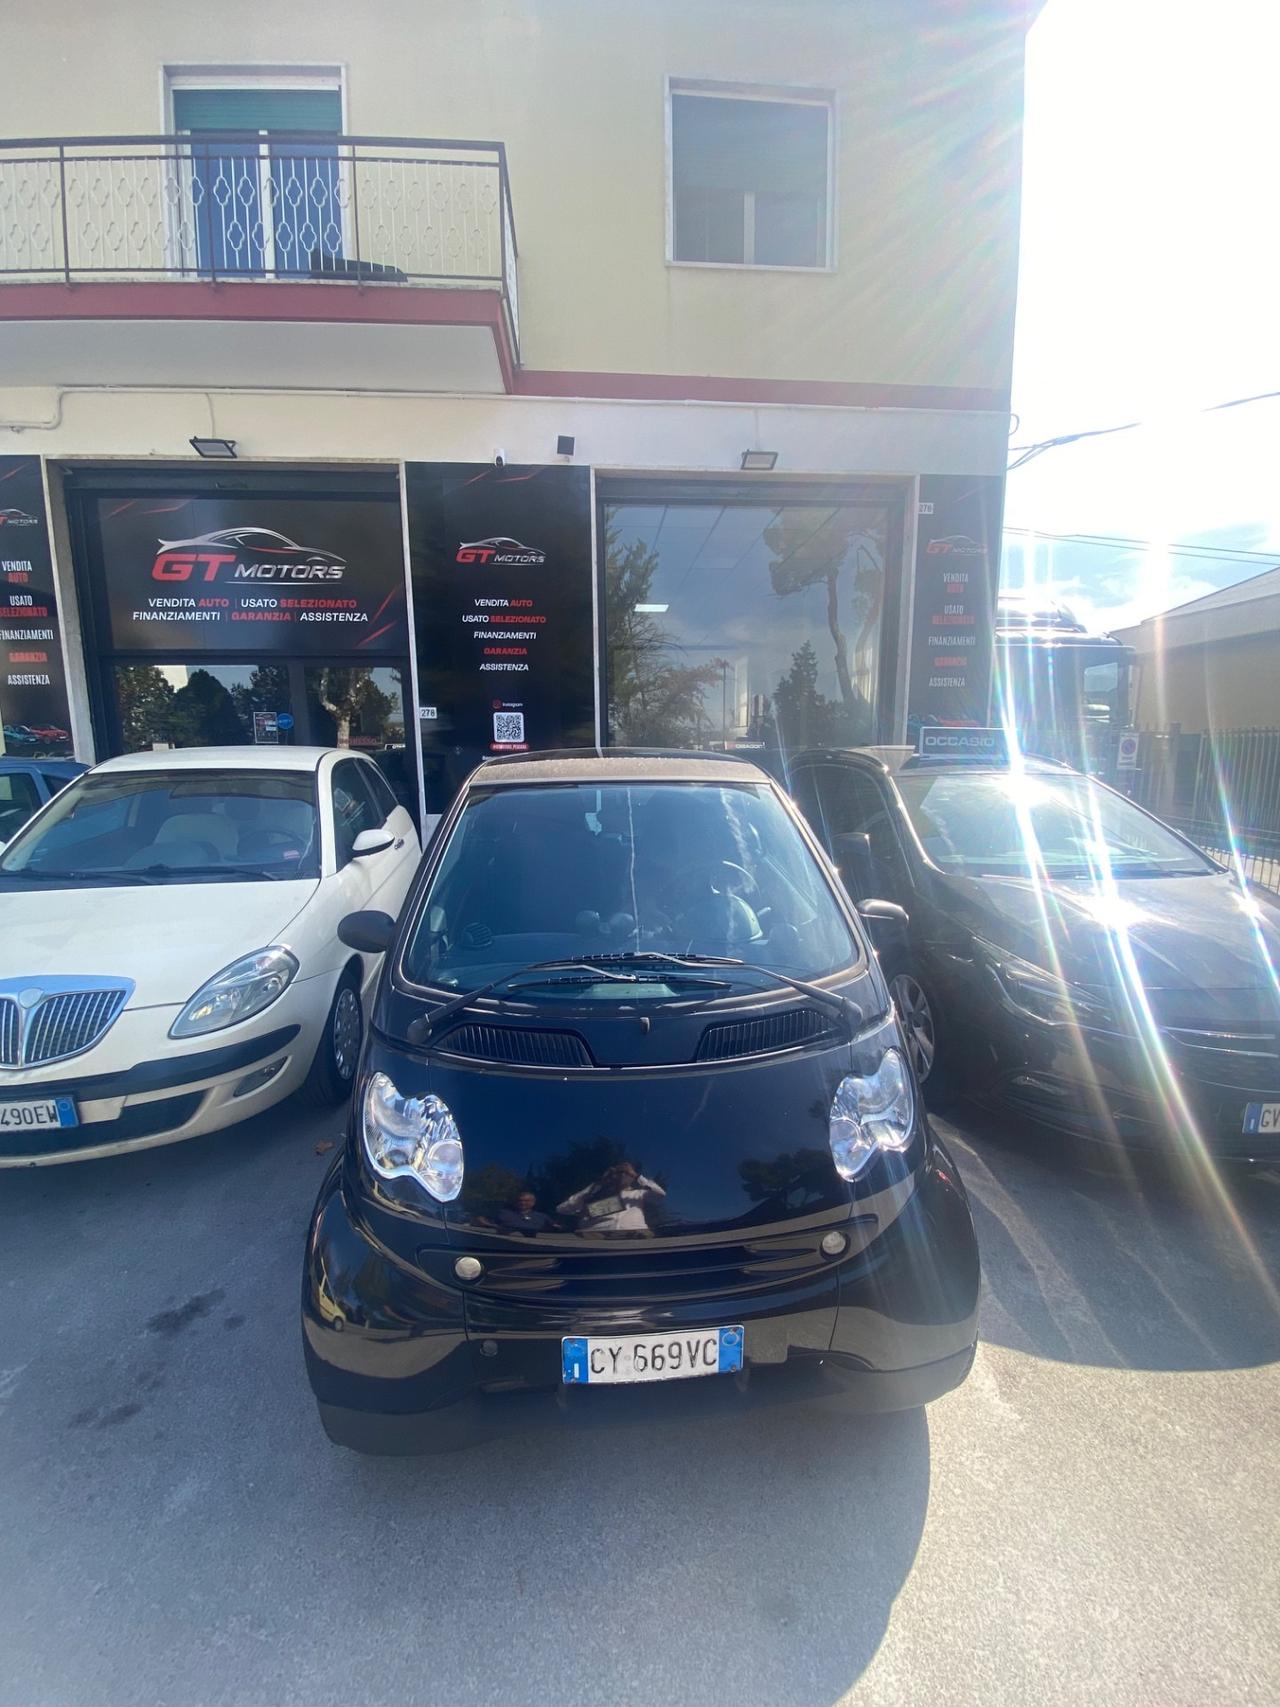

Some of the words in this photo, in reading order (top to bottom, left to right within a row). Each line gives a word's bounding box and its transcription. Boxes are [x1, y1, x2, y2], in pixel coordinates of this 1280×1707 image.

[456, 548, 496, 563] GT
[494, 555, 545, 563] MOTORS
[2, 561, 32, 571] VENDITA
[152, 554, 236, 582] GT
[234, 564, 346, 579] MOTORS
[10, 595, 33, 606] USATO
[148, 598, 196, 608] VENDITA
[198, 599, 230, 608] AUTO
[241, 598, 278, 608] USATO
[280, 599, 358, 609] SELEZIONATO
[474, 599, 509, 607] VENDITA
[132, 612, 221, 621] FINANZIAMENTI
[231, 612, 292, 621] GARANZIA
[300, 612, 369, 622] ASSISTENZA
[462, 615, 490, 623] USATO
[490, 615, 547, 624] SELEZIONATO
[473, 631, 537, 640] FINANZIAMENTI
[483, 648, 528, 656] GARANZIA
[479, 663, 530, 672] ASSISTENZA
[7, 674, 51, 686] ASSISTENZA
[421, 709, 436, 718] 278
[0, 1105, 59, 1125] 490EW
[591, 1347, 622, 1374] CY
[634, 1338, 717, 1372] 669VC
